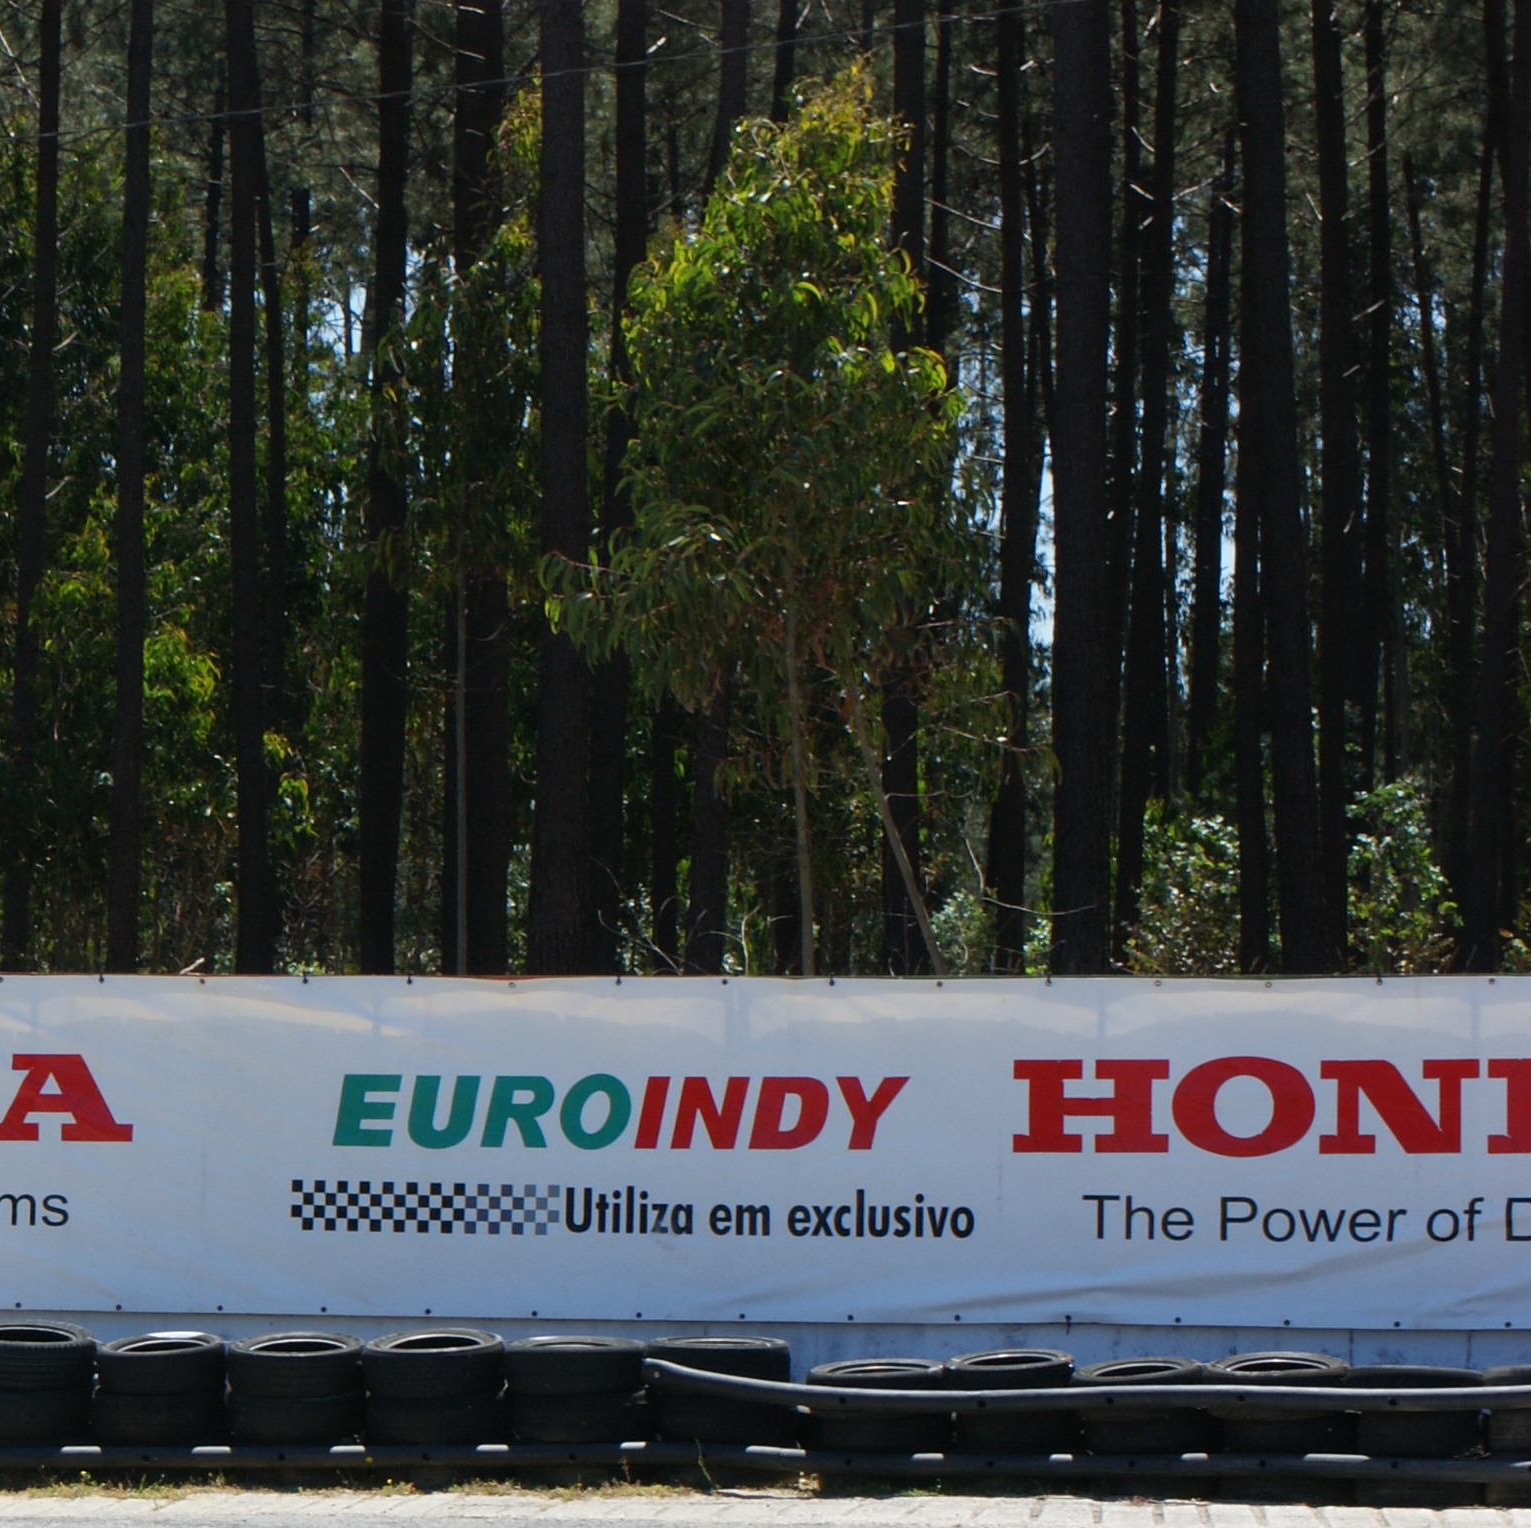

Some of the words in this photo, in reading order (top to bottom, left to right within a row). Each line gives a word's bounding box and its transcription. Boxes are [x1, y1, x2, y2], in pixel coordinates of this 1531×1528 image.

[332, 1073, 911, 1150] EUROINDY
[564, 1186, 694, 1236] Utiliza
[709, 1198, 772, 1238] em
[787, 1189, 976, 1239] exclusivo
[1082, 1194, 1195, 1240] The
[1220, 1196, 1407, 1243] Power
[1426, 1196, 1485, 1242] of
